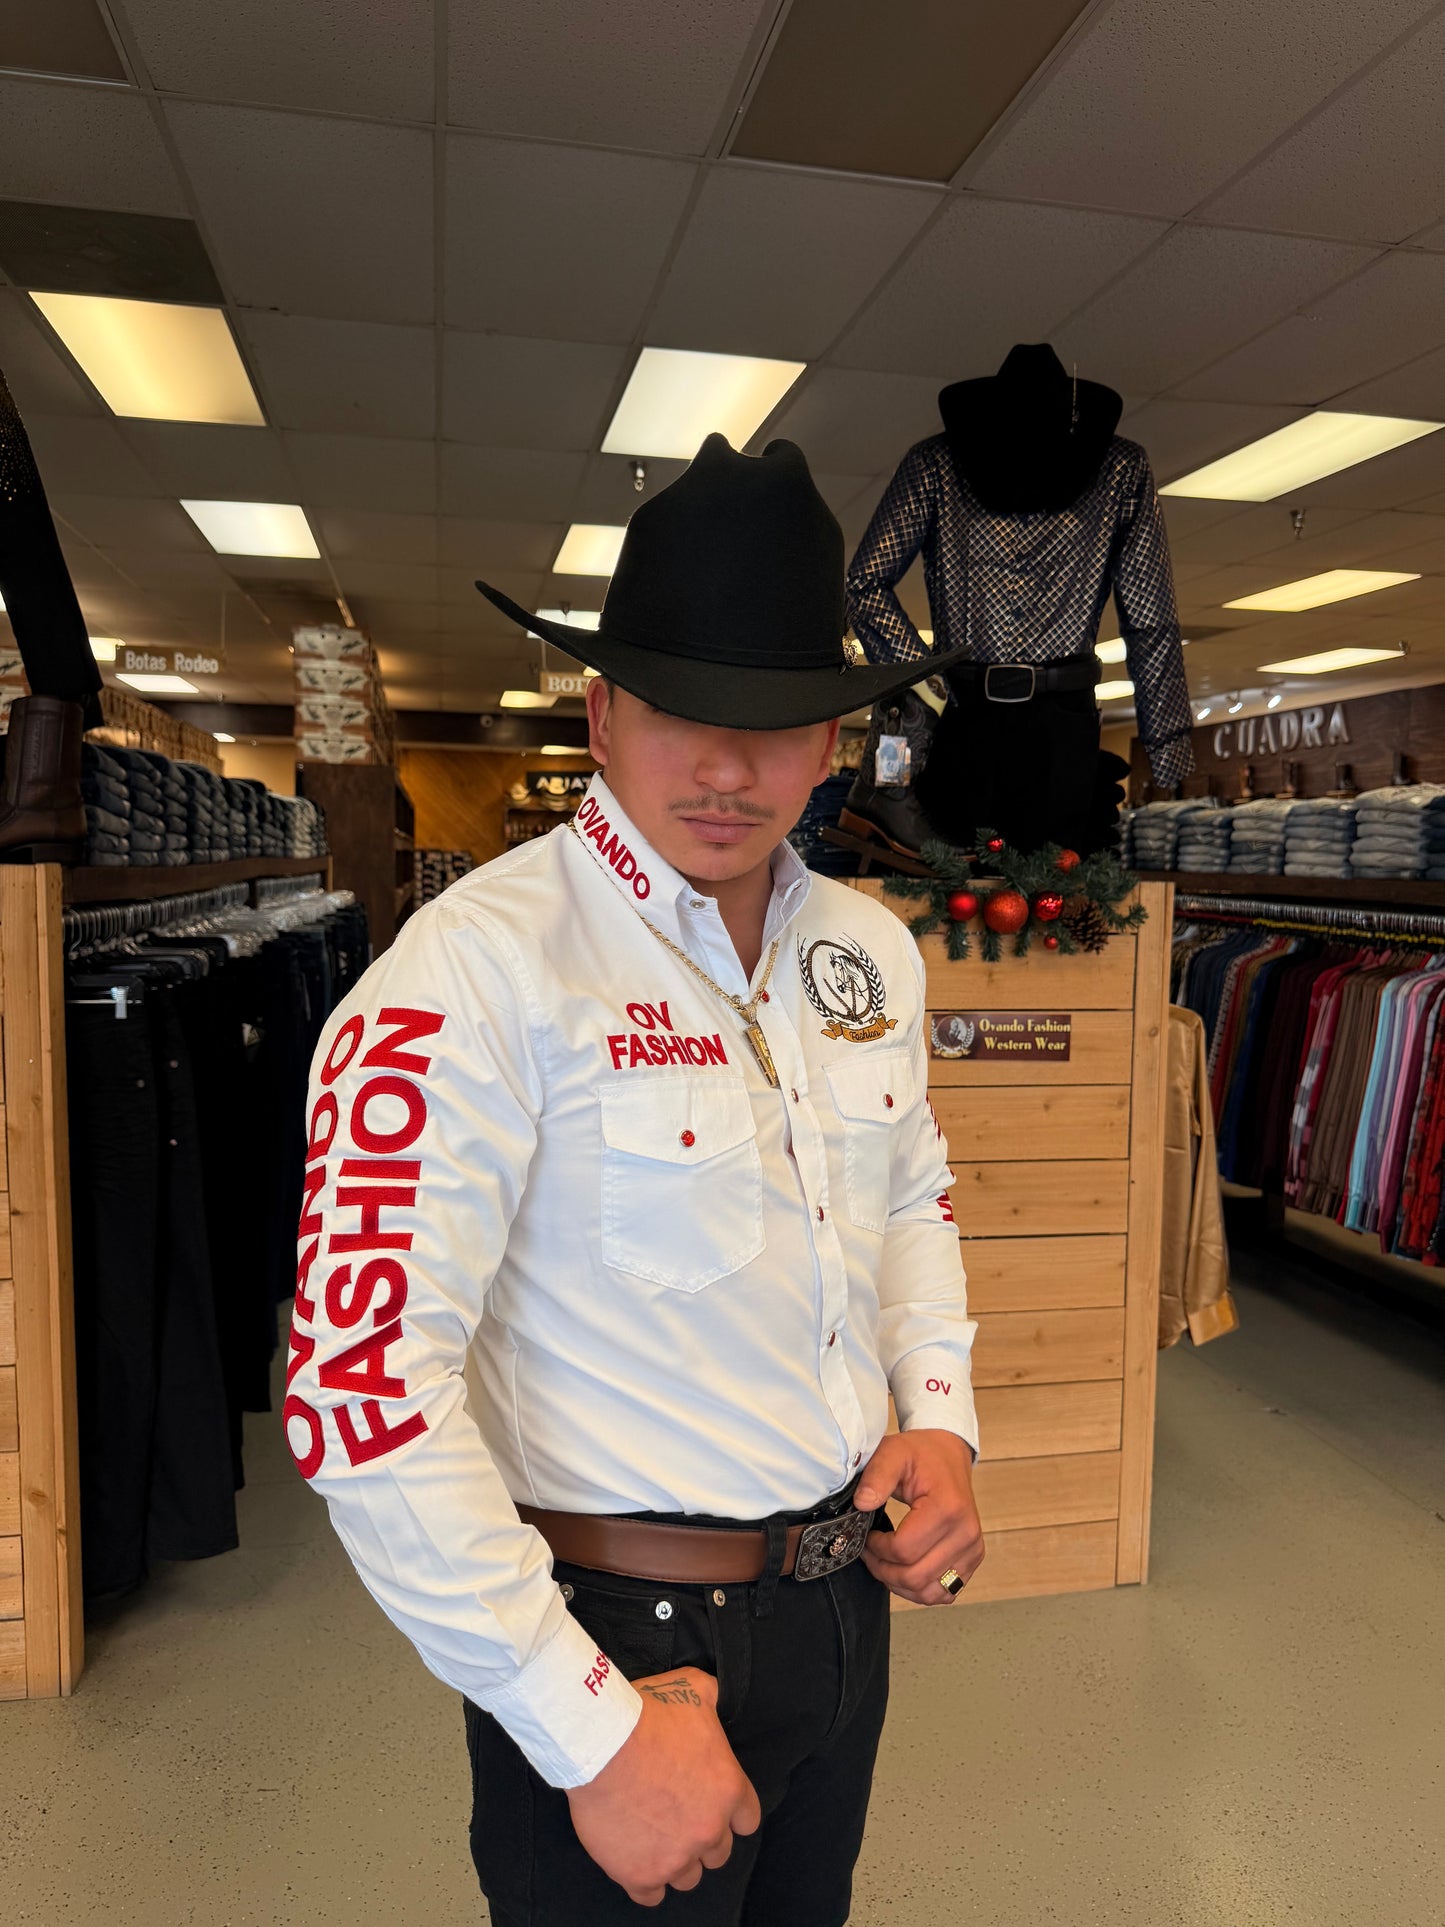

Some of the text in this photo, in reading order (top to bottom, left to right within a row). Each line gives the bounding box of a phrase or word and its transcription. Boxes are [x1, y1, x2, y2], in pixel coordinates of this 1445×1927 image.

[125, 650, 219, 673] Botas Rodeo
[547, 675, 588, 693] BOT
[1213, 702, 1350, 759] CUADRA
[536, 775, 592, 791] AIAT
[578, 796, 651, 900] OVANDO
[625, 1001, 674, 1031] OV
[979, 1018, 1071, 1032] Ovando Fashion
[606, 1033, 729, 1071] FASHION
[984, 1037, 1067, 1051] Western Wear
[282, 1014, 365, 1480] OVANDO
[318, 1007, 446, 1467] FASHION
[925, 1378, 951, 1396] OV
